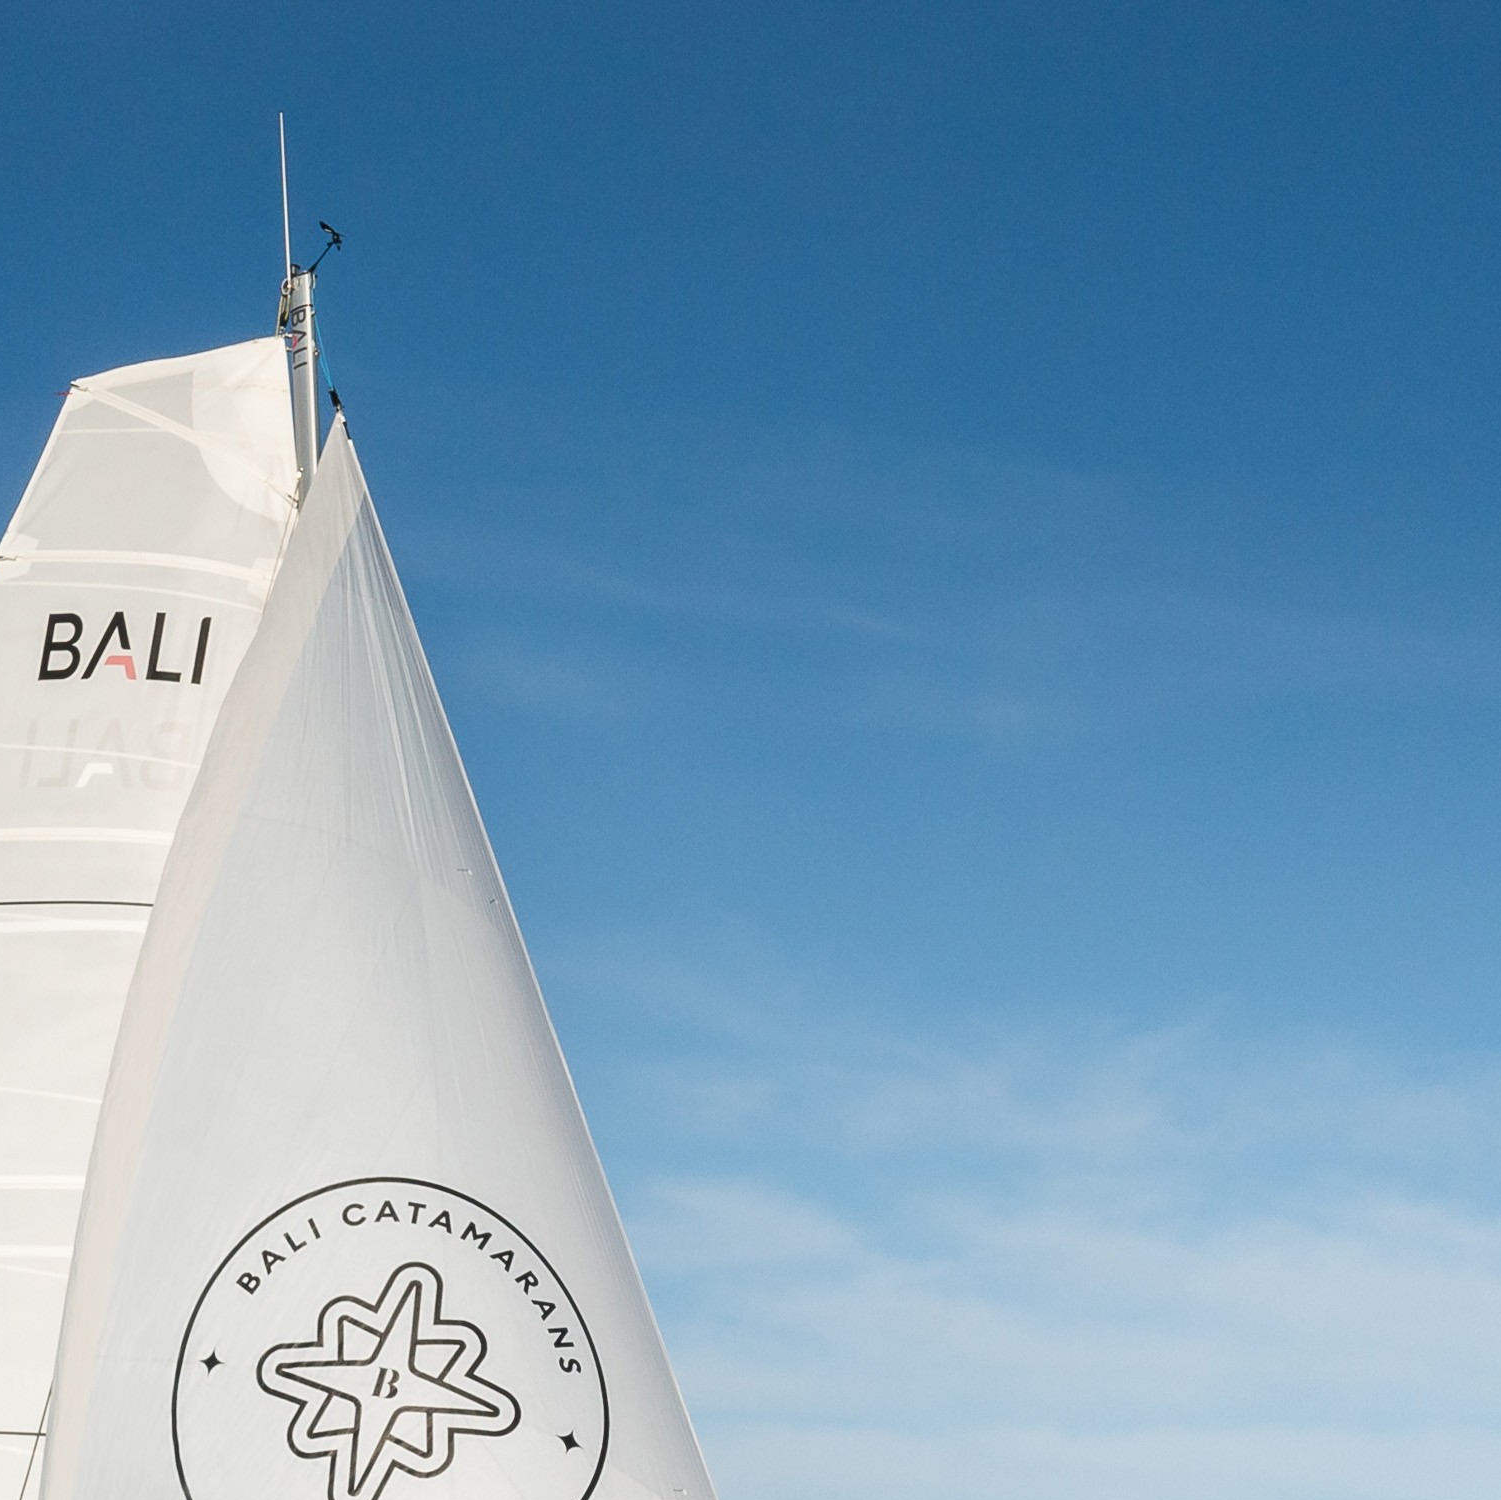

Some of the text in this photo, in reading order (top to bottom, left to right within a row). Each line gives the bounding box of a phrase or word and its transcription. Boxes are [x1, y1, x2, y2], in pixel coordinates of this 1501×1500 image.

[291, 308, 308, 370] BALI
[38, 611, 212, 684] BALI
[236, 1200, 582, 1375] BALI CATAMARANS
[371, 1367, 400, 1399] B
